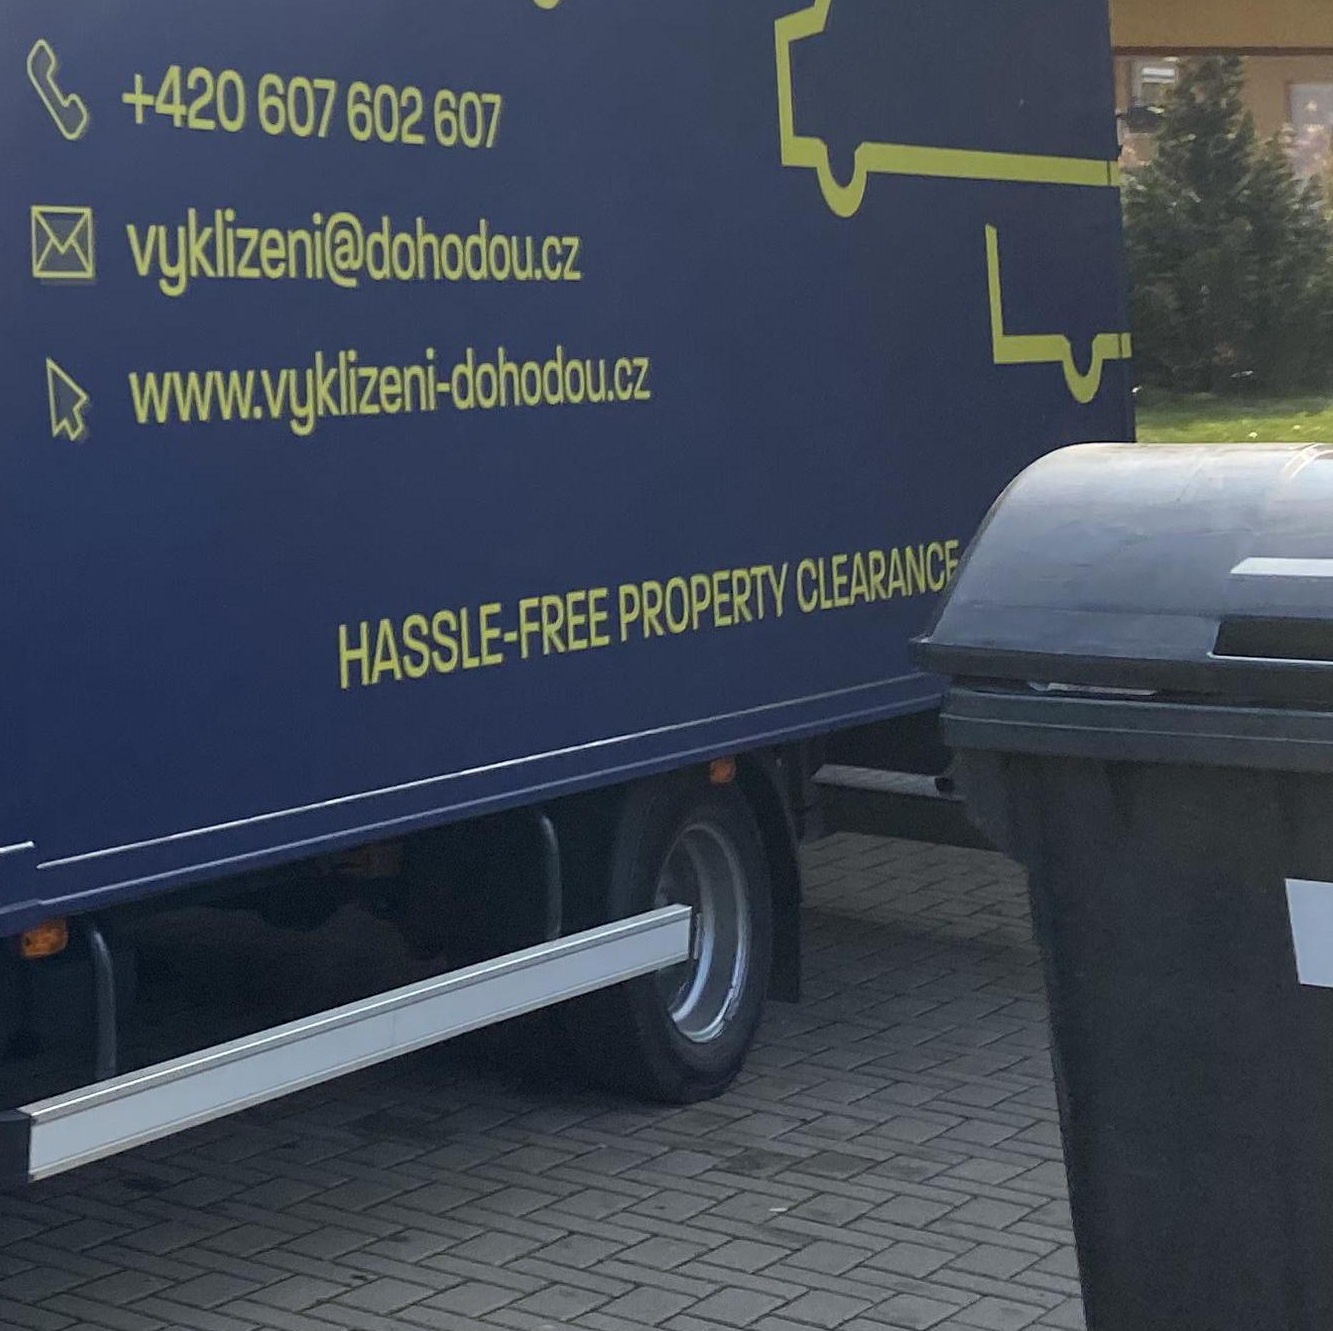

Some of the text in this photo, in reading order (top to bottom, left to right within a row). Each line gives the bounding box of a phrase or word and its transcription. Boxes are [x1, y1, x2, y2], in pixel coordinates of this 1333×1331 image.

[121, 65, 502, 148] +420 607 602 607
[126, 208, 583, 297] vyklizeni@dohodou.cz
[128, 346, 652, 437] www.vyklizeni-dohodou.cz
[338, 587, 609, 691] HASSLE-FREE
[620, 563, 788, 643] PROPERTY
